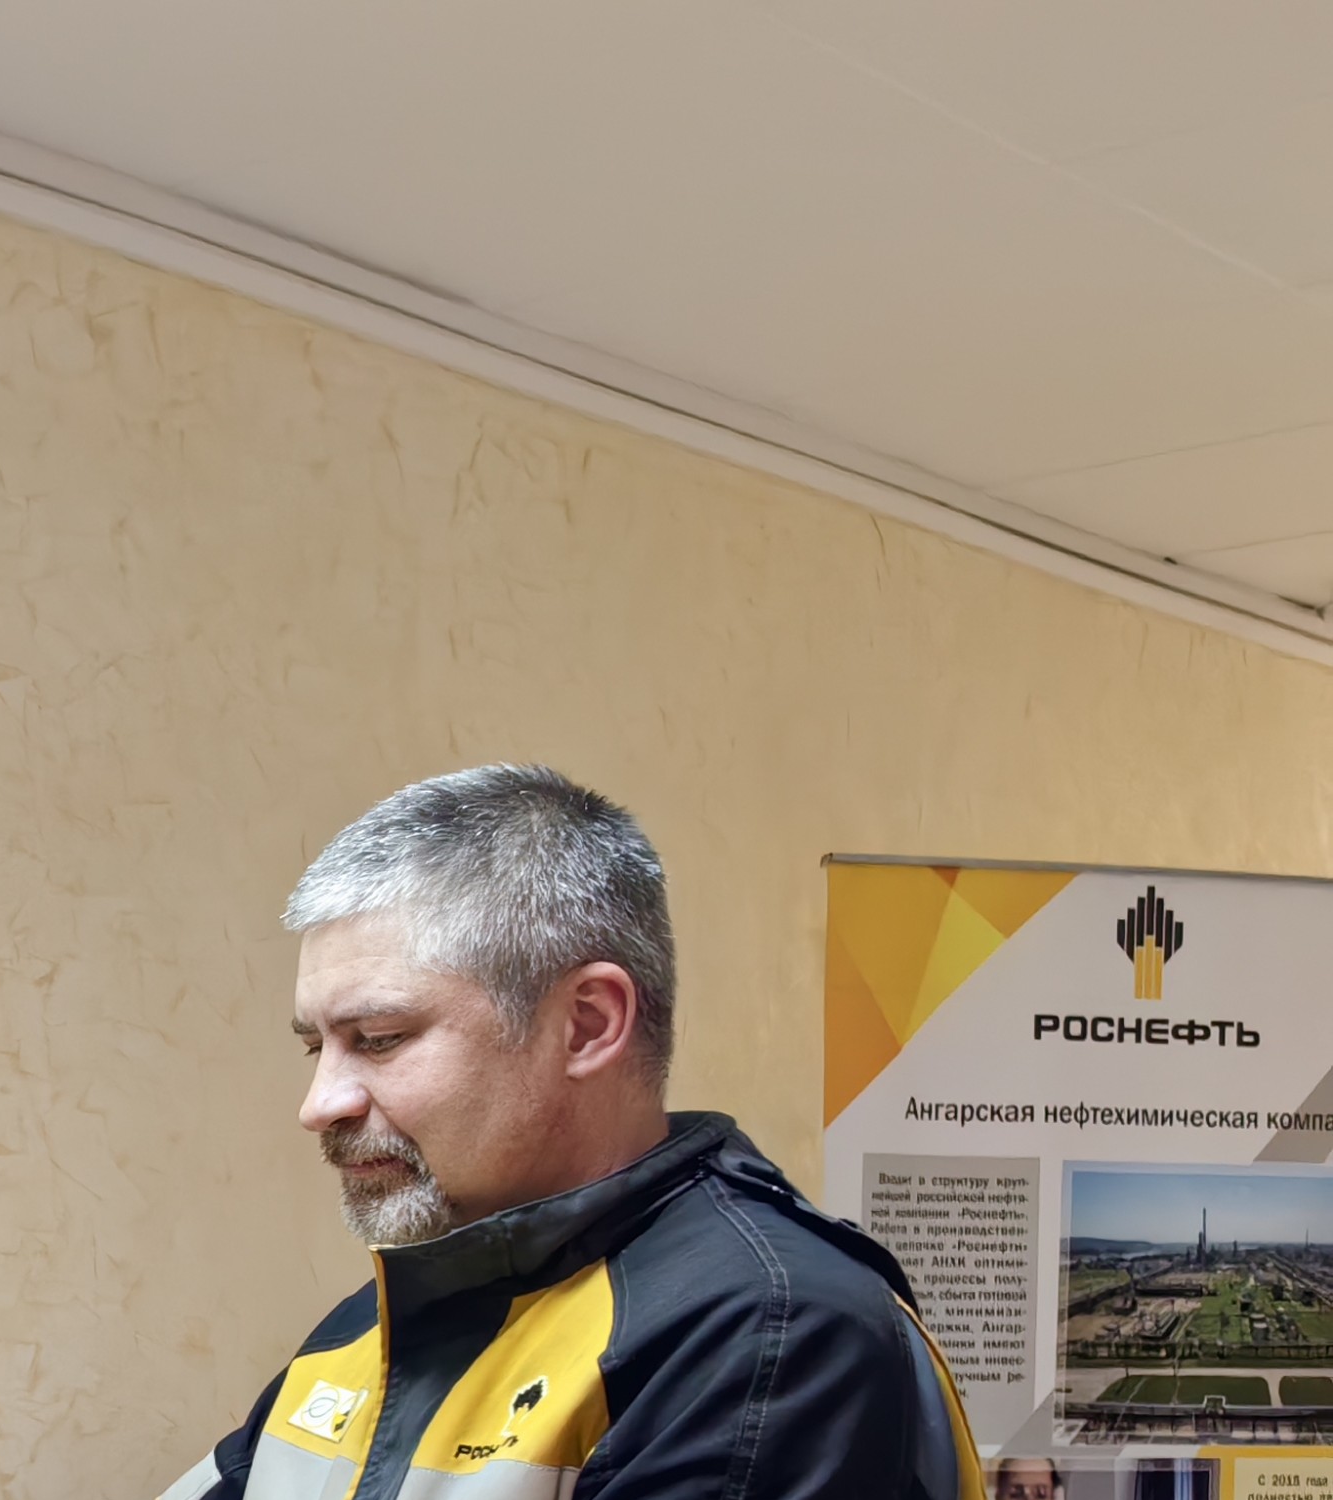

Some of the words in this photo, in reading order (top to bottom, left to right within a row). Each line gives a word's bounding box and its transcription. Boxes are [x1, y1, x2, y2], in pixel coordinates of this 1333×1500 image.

[1033, 1014, 1260, 1047] РОСНЕФТЬ
[905, 1096, 1035, 1127] Ангарская
[1044, 1101, 1258, 1130] нефтехимическая
